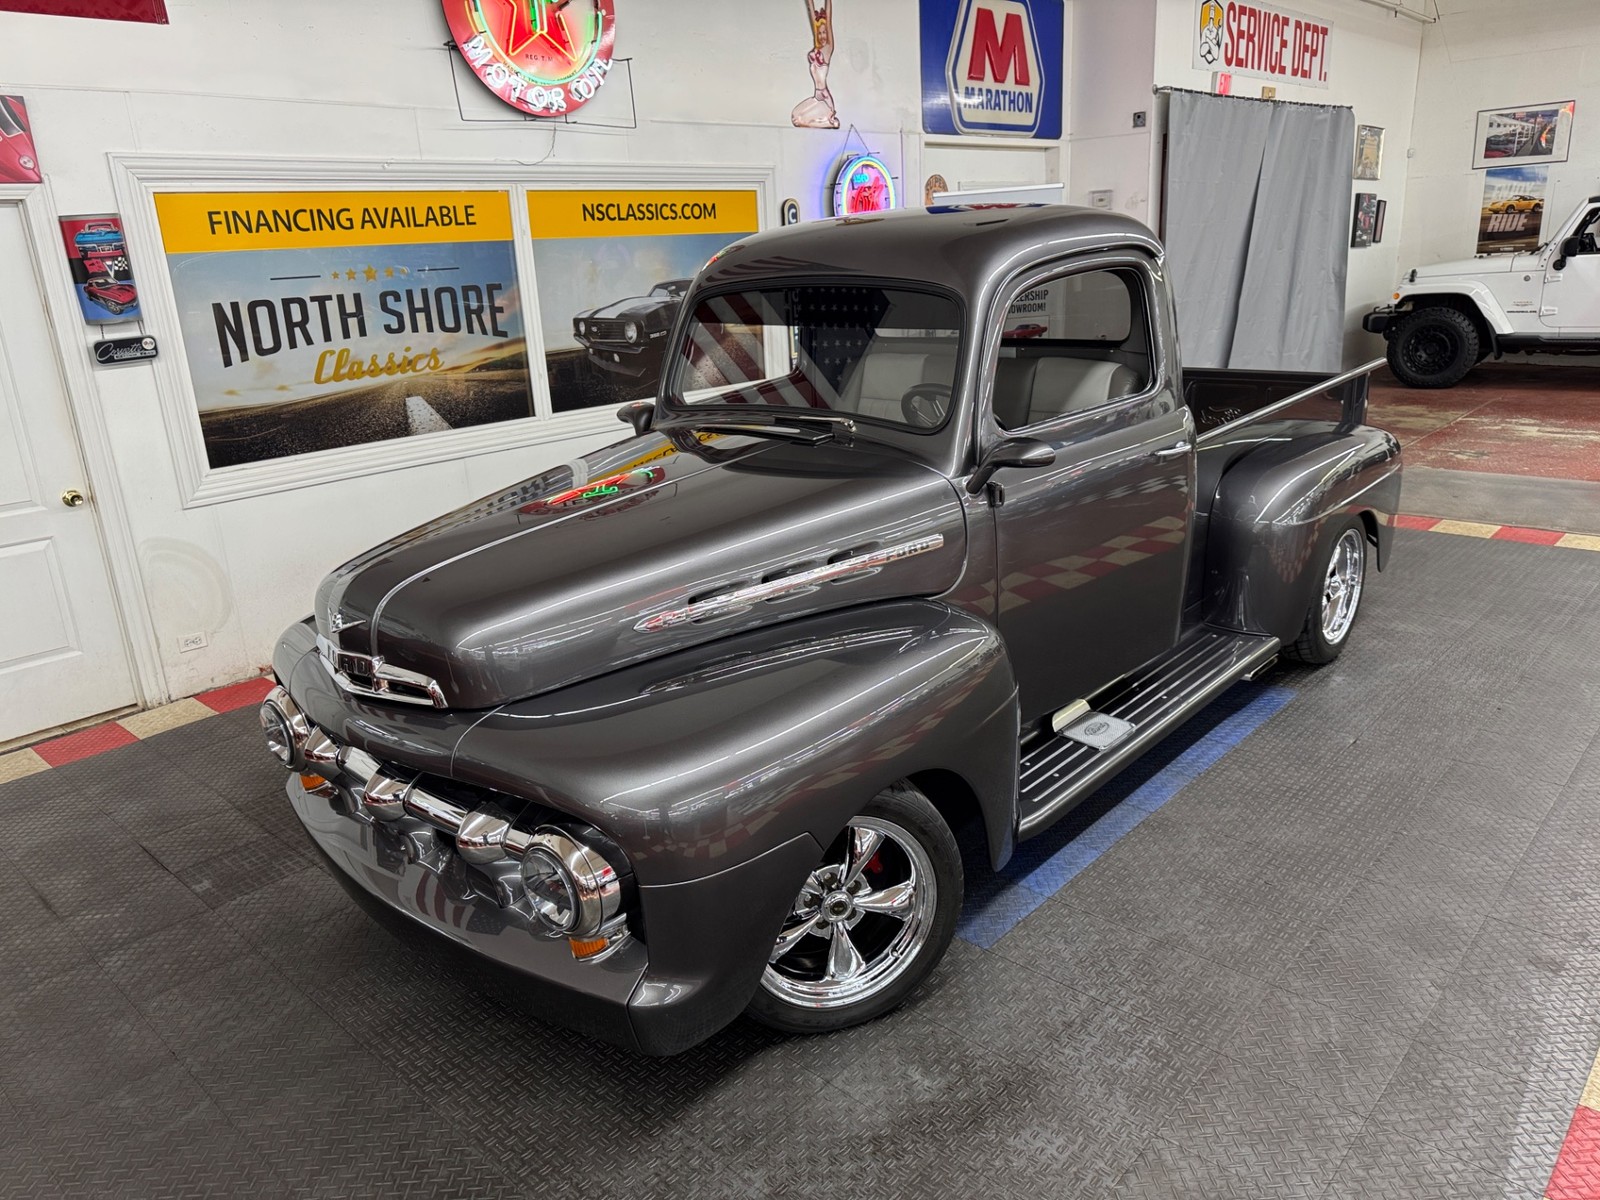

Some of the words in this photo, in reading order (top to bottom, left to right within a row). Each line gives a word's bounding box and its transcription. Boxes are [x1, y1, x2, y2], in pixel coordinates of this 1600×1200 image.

[967, 7, 1030, 86] M
[1224, 1, 1289, 76] SERVICE
[1290, 19, 1328, 83] DEPT.
[463, 34, 567, 113] MOTOR
[568, 58, 613, 102] OIL
[963, 86, 1033, 114] MARATHON
[207, 207, 354, 235] FINANCING
[360, 205, 477, 230] AVAILABLE
[582, 203, 717, 221] NSCLASSICS.COM
[1487, 213, 1530, 233] RIDE
[211, 292, 368, 369] NORTH
[378, 283, 509, 339] SHORE
[96, 342, 143, 361] Corvette
[313, 345, 445, 386] Classics
